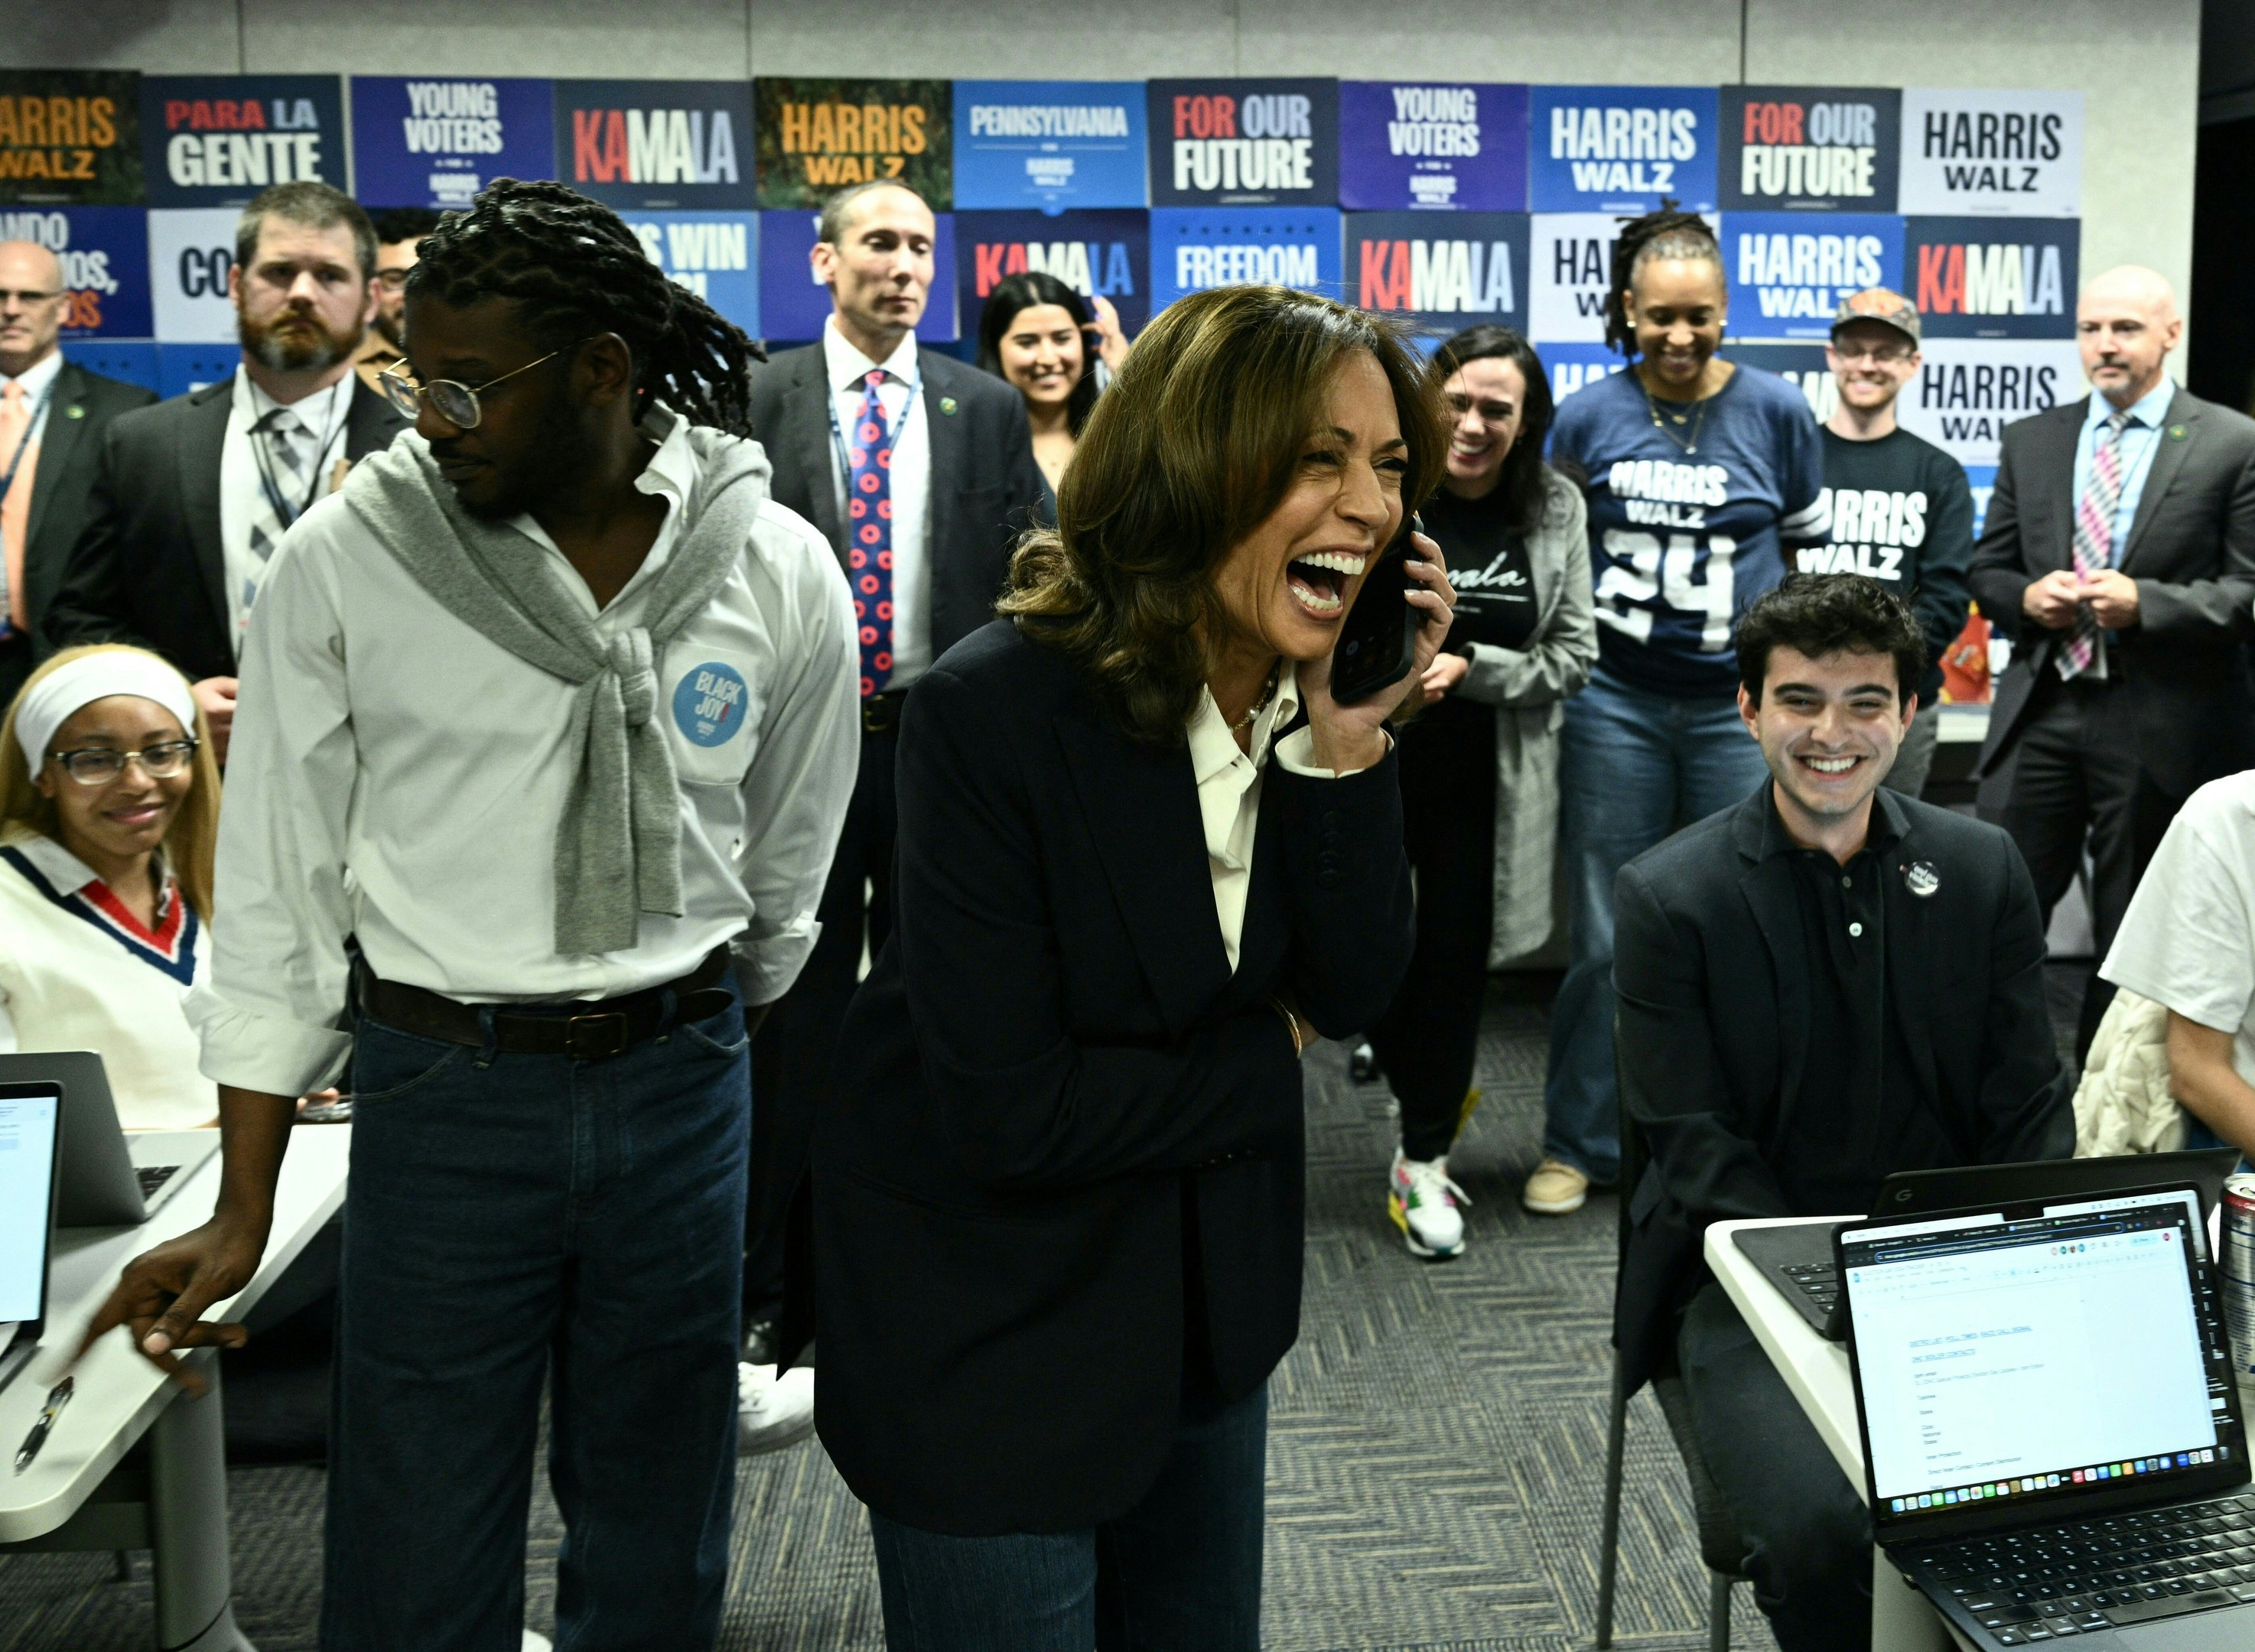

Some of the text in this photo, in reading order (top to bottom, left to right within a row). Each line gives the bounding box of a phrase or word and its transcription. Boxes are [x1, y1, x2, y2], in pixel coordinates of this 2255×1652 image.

[0, 96, 116, 148] ARRIS
[164, 100, 319, 129] PARA LA
[407, 83, 498, 118] YOUNG
[969, 105, 1130, 138] PENNSYLVANIA
[1173, 94, 1313, 138] FOR OUR
[1392, 88, 1477, 122] YOUNG
[404, 118, 503, 154] VOTERS
[782, 103, 927, 154] HARRIS
[1388, 122, 1480, 157] VOTERS
[1551, 108, 1697, 160] HARRIS
[1744, 102, 1876, 145] FOR OUR
[1924, 112, 2063, 161] HARRIS
[168, 133, 324, 187] GENTE
[572, 109, 739, 184] KAMALA
[1173, 139, 1313, 190] FUTURE
[805, 157, 906, 184] WALZ
[1571, 162, 1674, 192] WALZ
[1741, 145, 1876, 196] FUTURE
[1944, 166, 2039, 192] WALZ
[666, 223, 747, 271] WIN
[1176, 246, 1317, 288] FREEDOM
[1739, 233, 1882, 288] HARRIS
[1359, 239, 1515, 313] KAMALA
[1918, 246, 2065, 314] KAMALA
[1921, 365, 2058, 410] HARRIS
[1609, 460, 1729, 506] HARRIS
[1625, 499, 1707, 528] WALZ
[1796, 543, 1904, 581] WALZ
[1593, 528, 1736, 651] 24
[695, 670, 743, 705] BLACK
